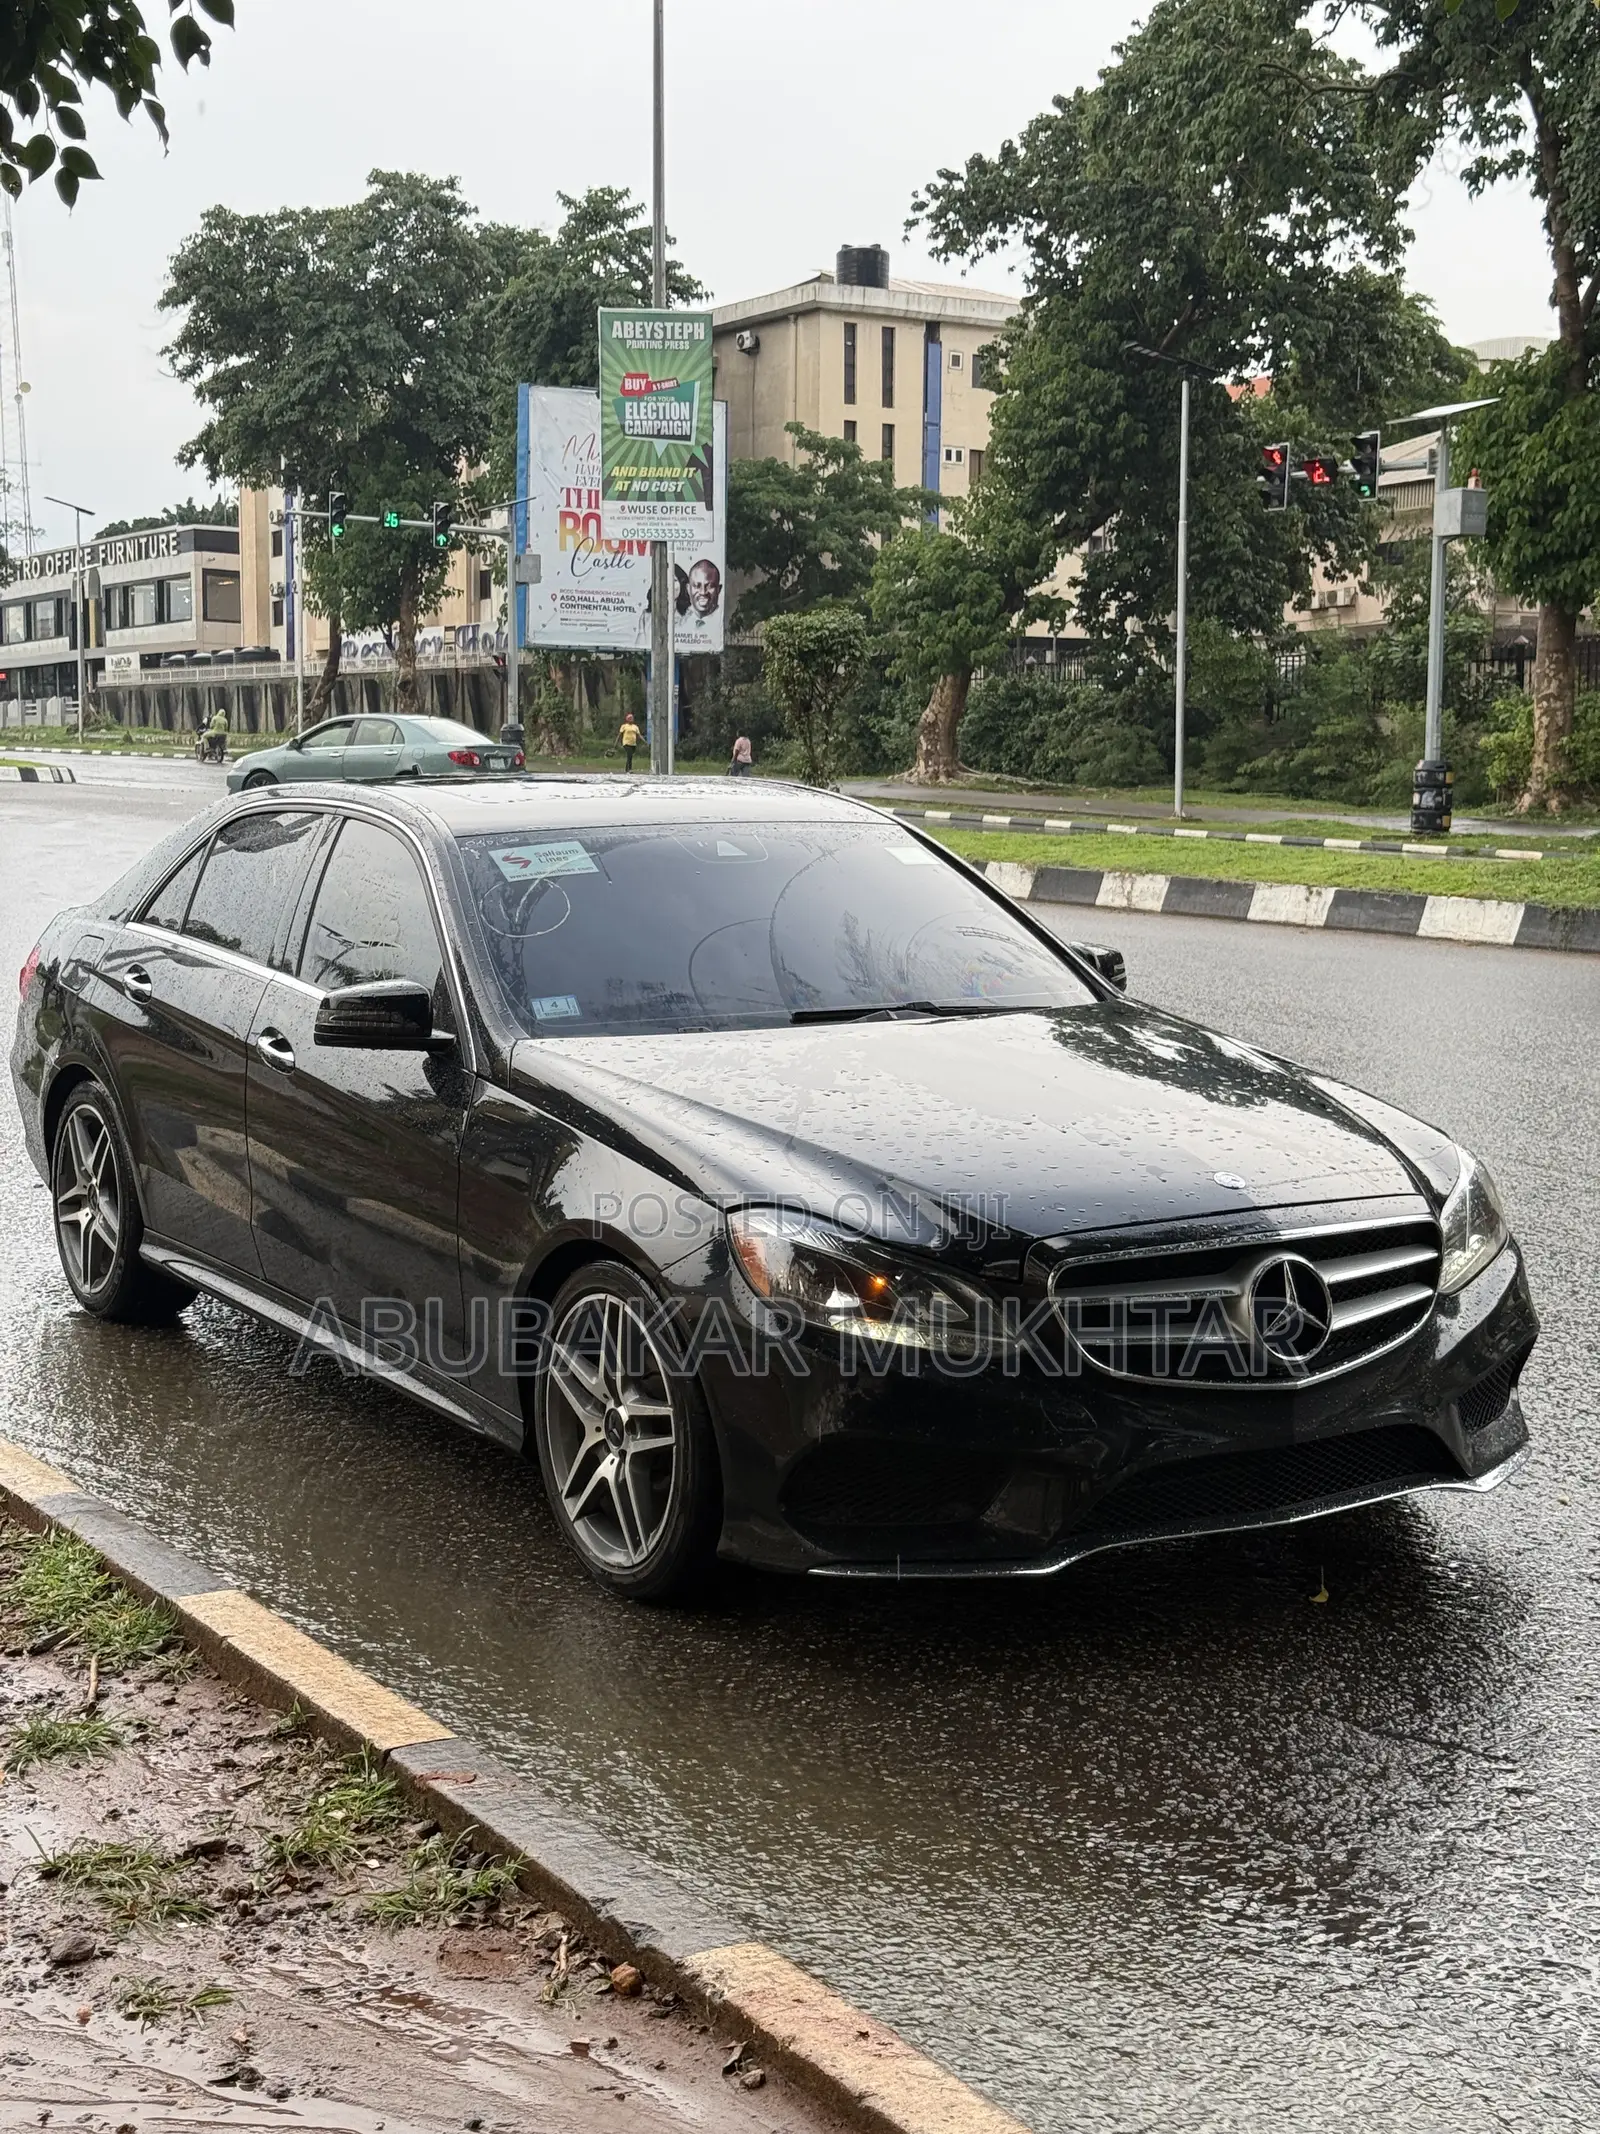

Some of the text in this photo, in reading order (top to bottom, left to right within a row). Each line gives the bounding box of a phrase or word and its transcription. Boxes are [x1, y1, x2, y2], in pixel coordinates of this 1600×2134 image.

[611, 320, 705, 340] ABEYSTEPH
[626, 340, 690, 350] PRINTING PRESS
[624, 377, 647, 391] BUY
[625, 401, 690, 420] ELECTION
[624, 420, 691, 436] CAMPAIGN
[610, 466, 697, 478] AND BRAND IT
[613, 480, 685, 493] AT NO COST
[627, 505, 697, 515] WUSE OFFICE
[622, 528, 694, 539] 09135333333
[99, 532, 178, 567] FURNITURE
[570, 536, 635, 578] Castle
[600, 597, 626, 605] ABUJA
[560, 602, 637, 614] CONTINENTAL HOTEL
[534, 848, 579, 858] Sallaum
[537, 855, 570, 864] Lines
